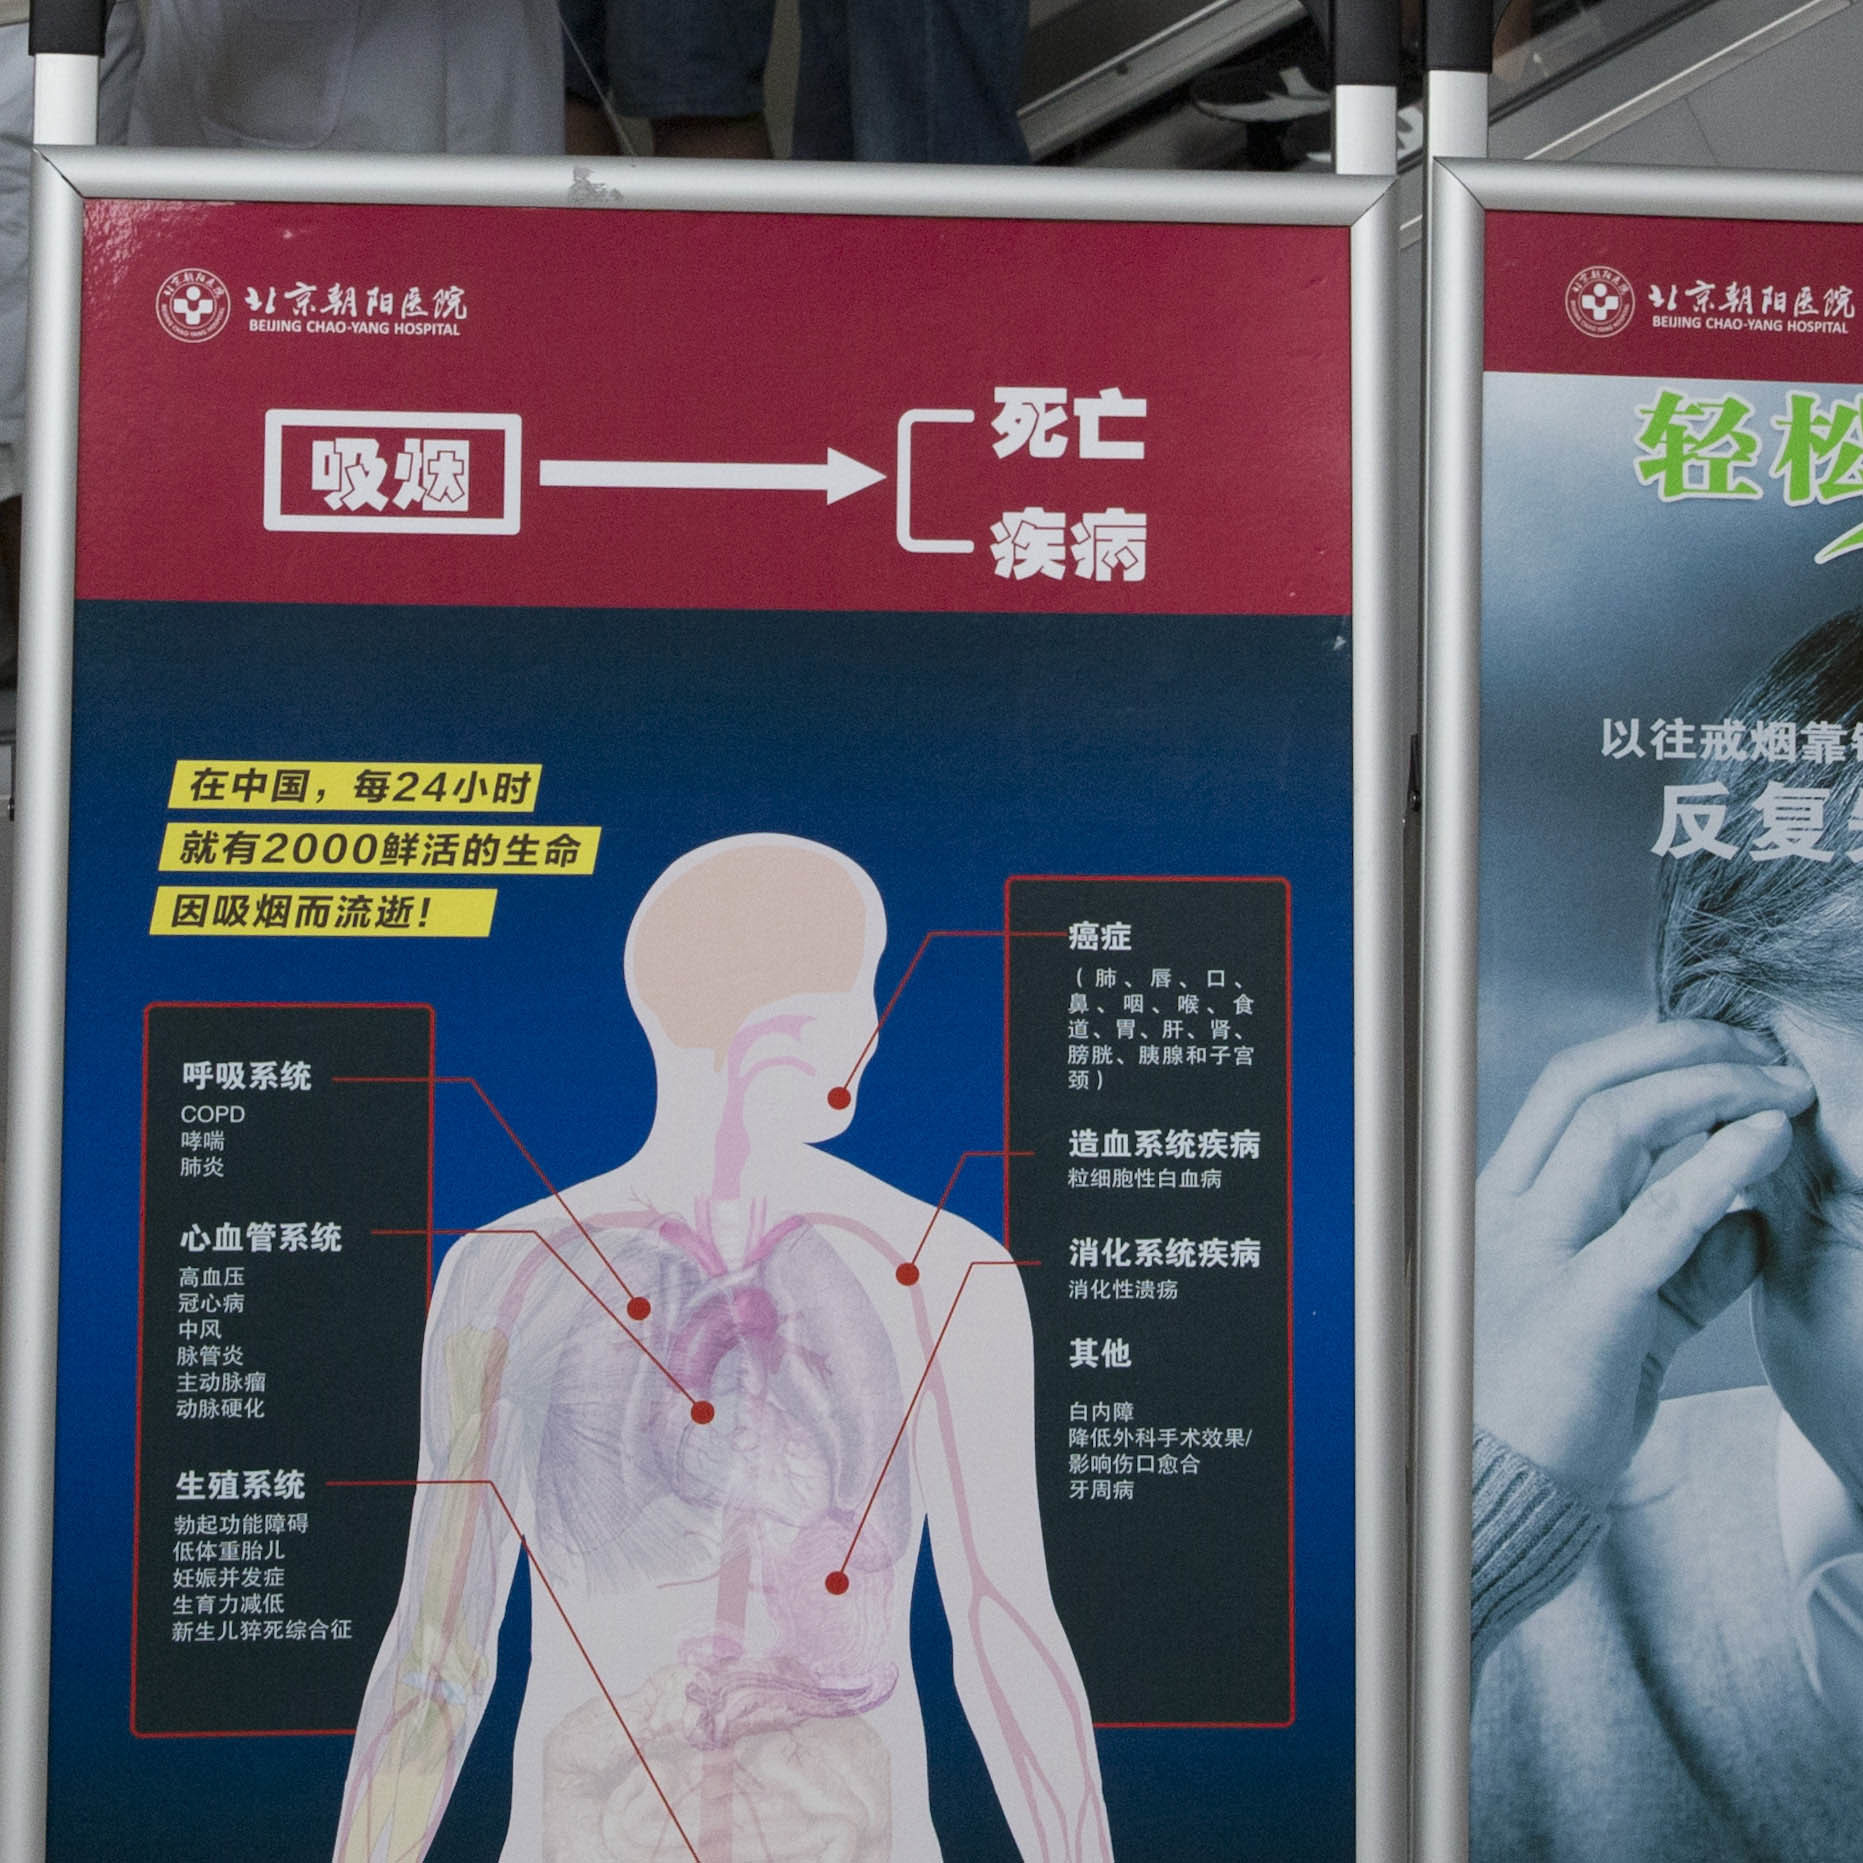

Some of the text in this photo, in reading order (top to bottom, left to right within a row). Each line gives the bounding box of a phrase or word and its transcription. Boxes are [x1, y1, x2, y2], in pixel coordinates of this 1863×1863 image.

[243, 281, 468, 320] 北京朝阳医院
[1647, 280, 1856, 319] 北京朝阳医院
[248, 319, 461, 336] BEIJING CHAO-YANG HOSPITAL
[1652, 315, 1849, 334] BEIJING CHAO-YANG HOSPITAL
[990, 385, 1149, 461] 死亡
[308, 437, 472, 515] 吸烟
[988, 505, 1148, 582] 疾病
[179, 829, 582, 868] 就有2000鲜活的生命
[171, 893, 432, 930] 因吸烟而流逝！
[1068, 921, 1133, 951] 癌症
[1067, 1045, 1255, 1067] 膀胱、胰腺和子宫
[182, 1060, 312, 1091] 呼吸系统
[180, 1105, 246, 1124] COPD
[180, 1130, 225, 1152] 哮喘
[1068, 1128, 1261, 1160] 造血系统疾病
[179, 1156, 225, 1178] 肺炎
[1067, 1167, 1223, 1189] 粒细胞性白血病
[179, 1222, 343, 1253] 心血管系统
[1068, 1237, 1262, 1268] 消化系统疾病
[178, 1266, 246, 1288] 高血压
[1068, 1279, 1179, 1300] 消化性溃疡
[177, 1292, 246, 1314] 冠心病
[178, 1319, 222, 1341] 中风
[176, 1345, 245, 1367] 脉管炎
[1068, 1337, 1133, 1368] 其他
[176, 1371, 267, 1394] 主动脉瘤
[175, 1397, 266, 1420] 动脉硬化
[1068, 1401, 1135, 1423] 白内障
[1068, 1427, 1253, 1448] 降低外科手术效果/
[1067, 1453, 1201, 1475] 影响伤口愈合
[175, 1468, 306, 1500] 生殖系统
[1068, 1479, 1135, 1501] 牙周病
[173, 1512, 309, 1535] 勃起功能障碍
[172, 1539, 286, 1562] 低体重胎儿
[172, 1566, 286, 1589] 妊娠并发症
[172, 1593, 285, 1615] 生育力减低
[171, 1618, 353, 1642] 新生儿猝死综合征
